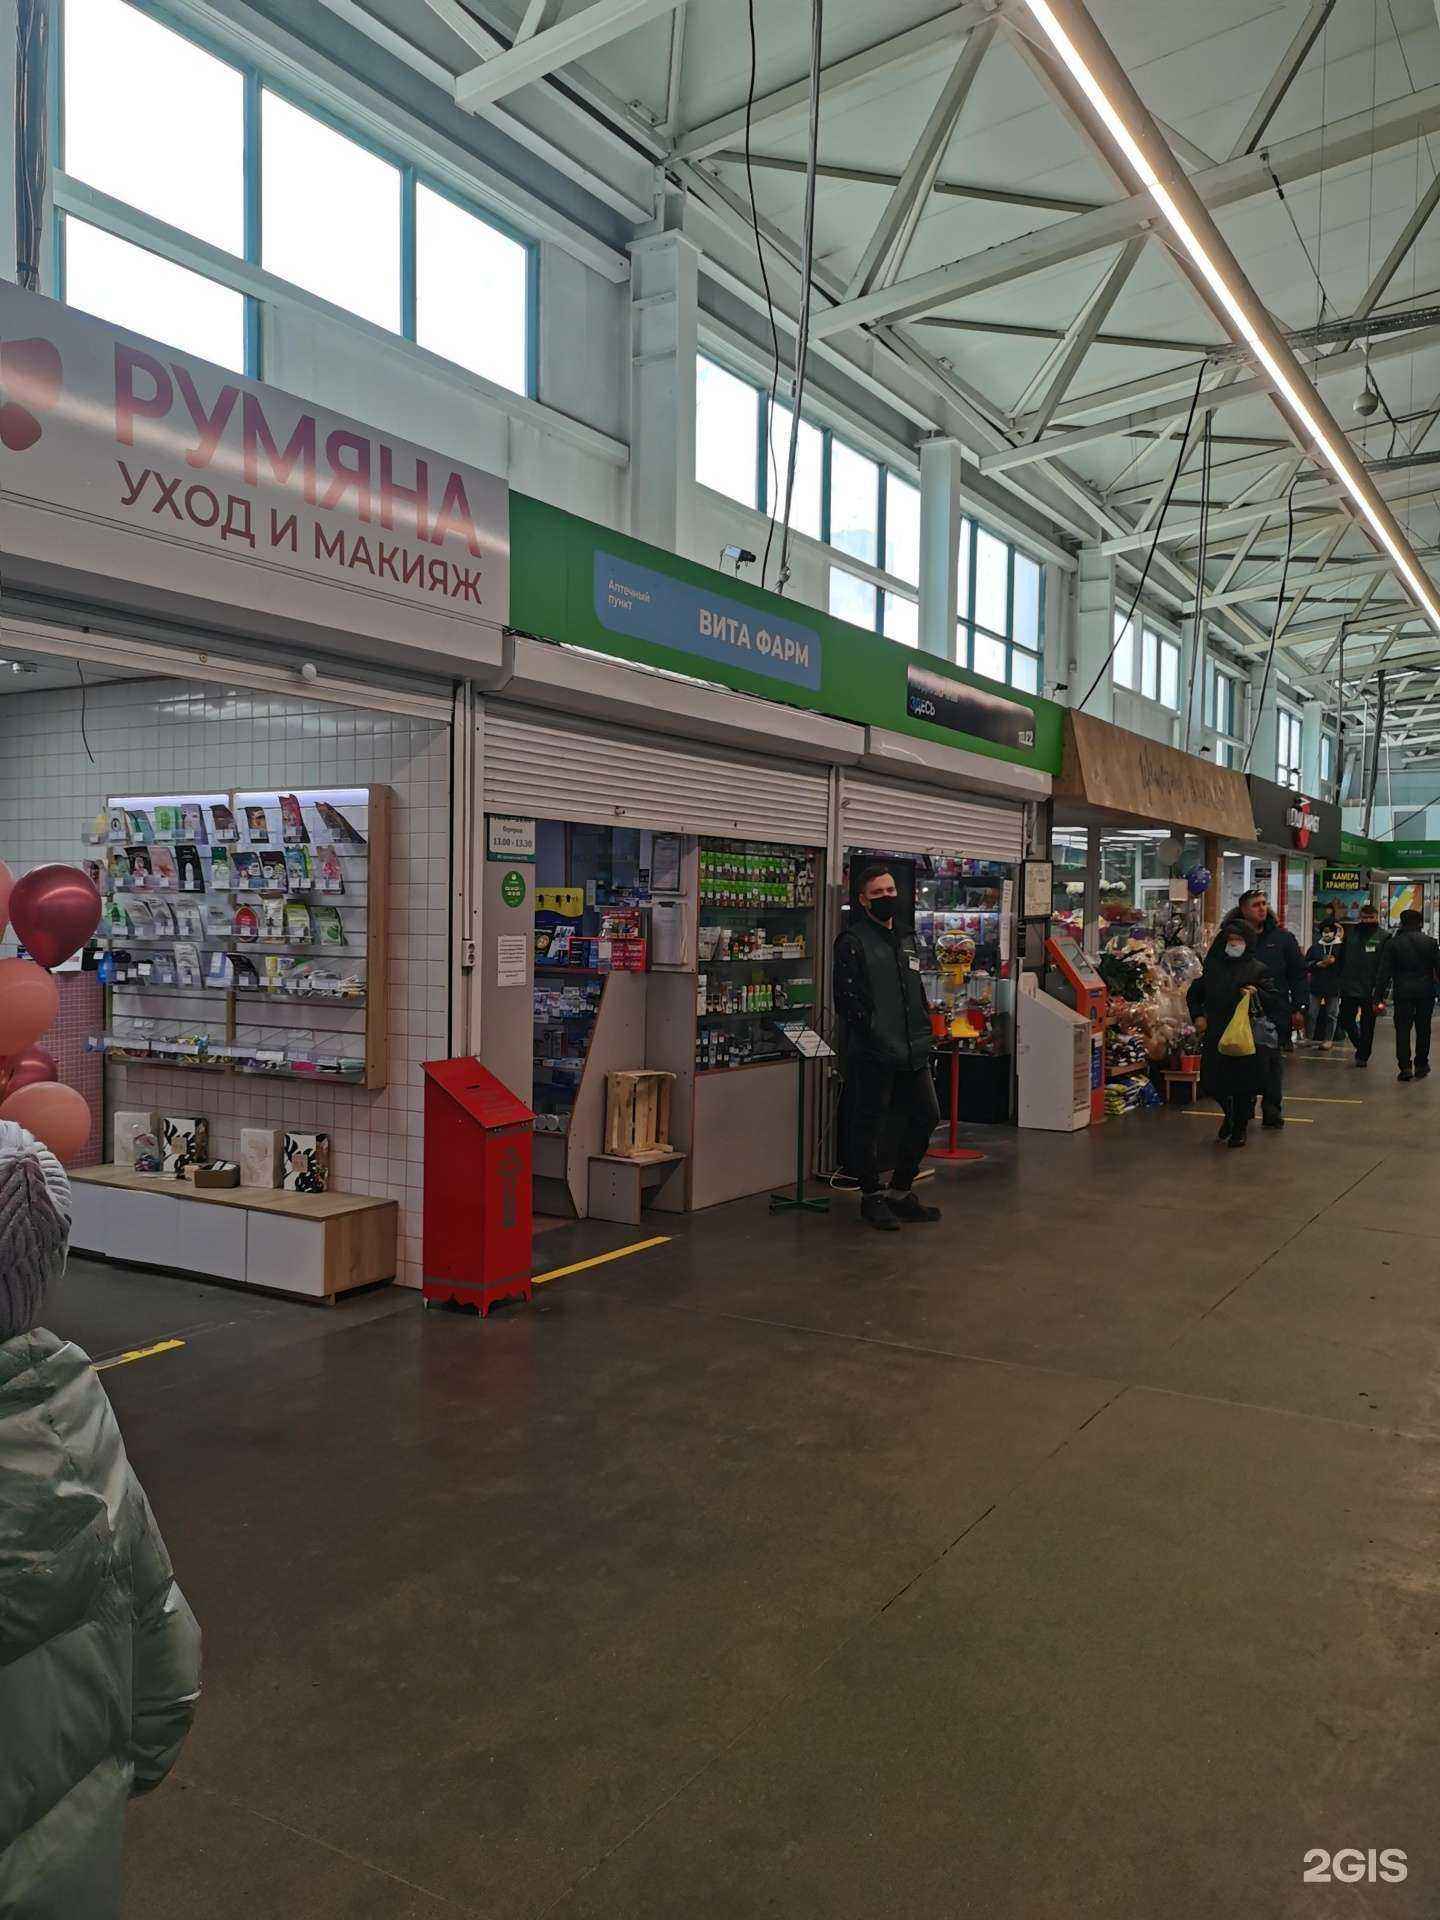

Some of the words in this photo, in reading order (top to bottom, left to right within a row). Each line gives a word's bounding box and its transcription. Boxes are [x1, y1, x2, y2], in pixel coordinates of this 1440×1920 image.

[114, 341, 482, 559] РУМЯНА
[115, 460, 256, 549] УХОД
[270, 507, 298, 553] И
[314, 521, 483, 605] МАКИЯЖ
[608, 579, 651, 604] Аптечный
[698, 608, 752, 650] ВИТА
[755, 629, 809, 668] ФАРМ
[1332, 872, 1359, 880] КАМЕРА
